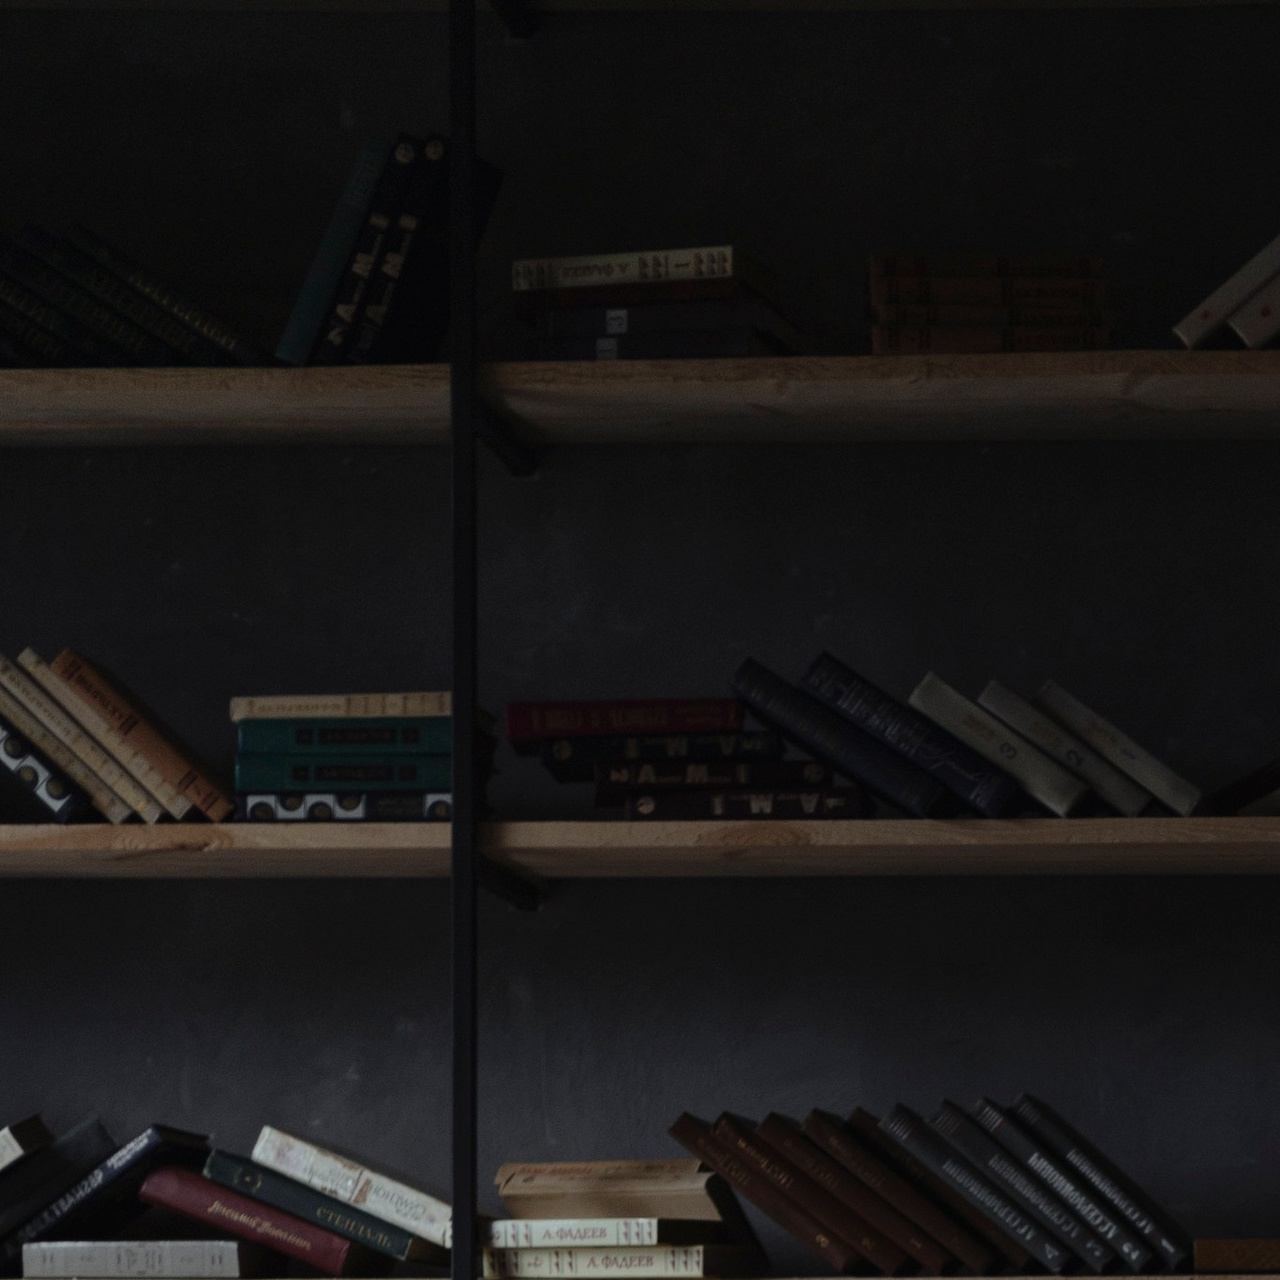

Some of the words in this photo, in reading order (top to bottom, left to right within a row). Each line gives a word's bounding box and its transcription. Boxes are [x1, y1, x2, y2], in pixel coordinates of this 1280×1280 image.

[314, 1204, 394, 1248] СТЕНДАЛЬ
[542, 1227, 607, 1240] А.ФАДЕЕВ
[586, 1253, 654, 1269] А.ФАДЕЕВ
